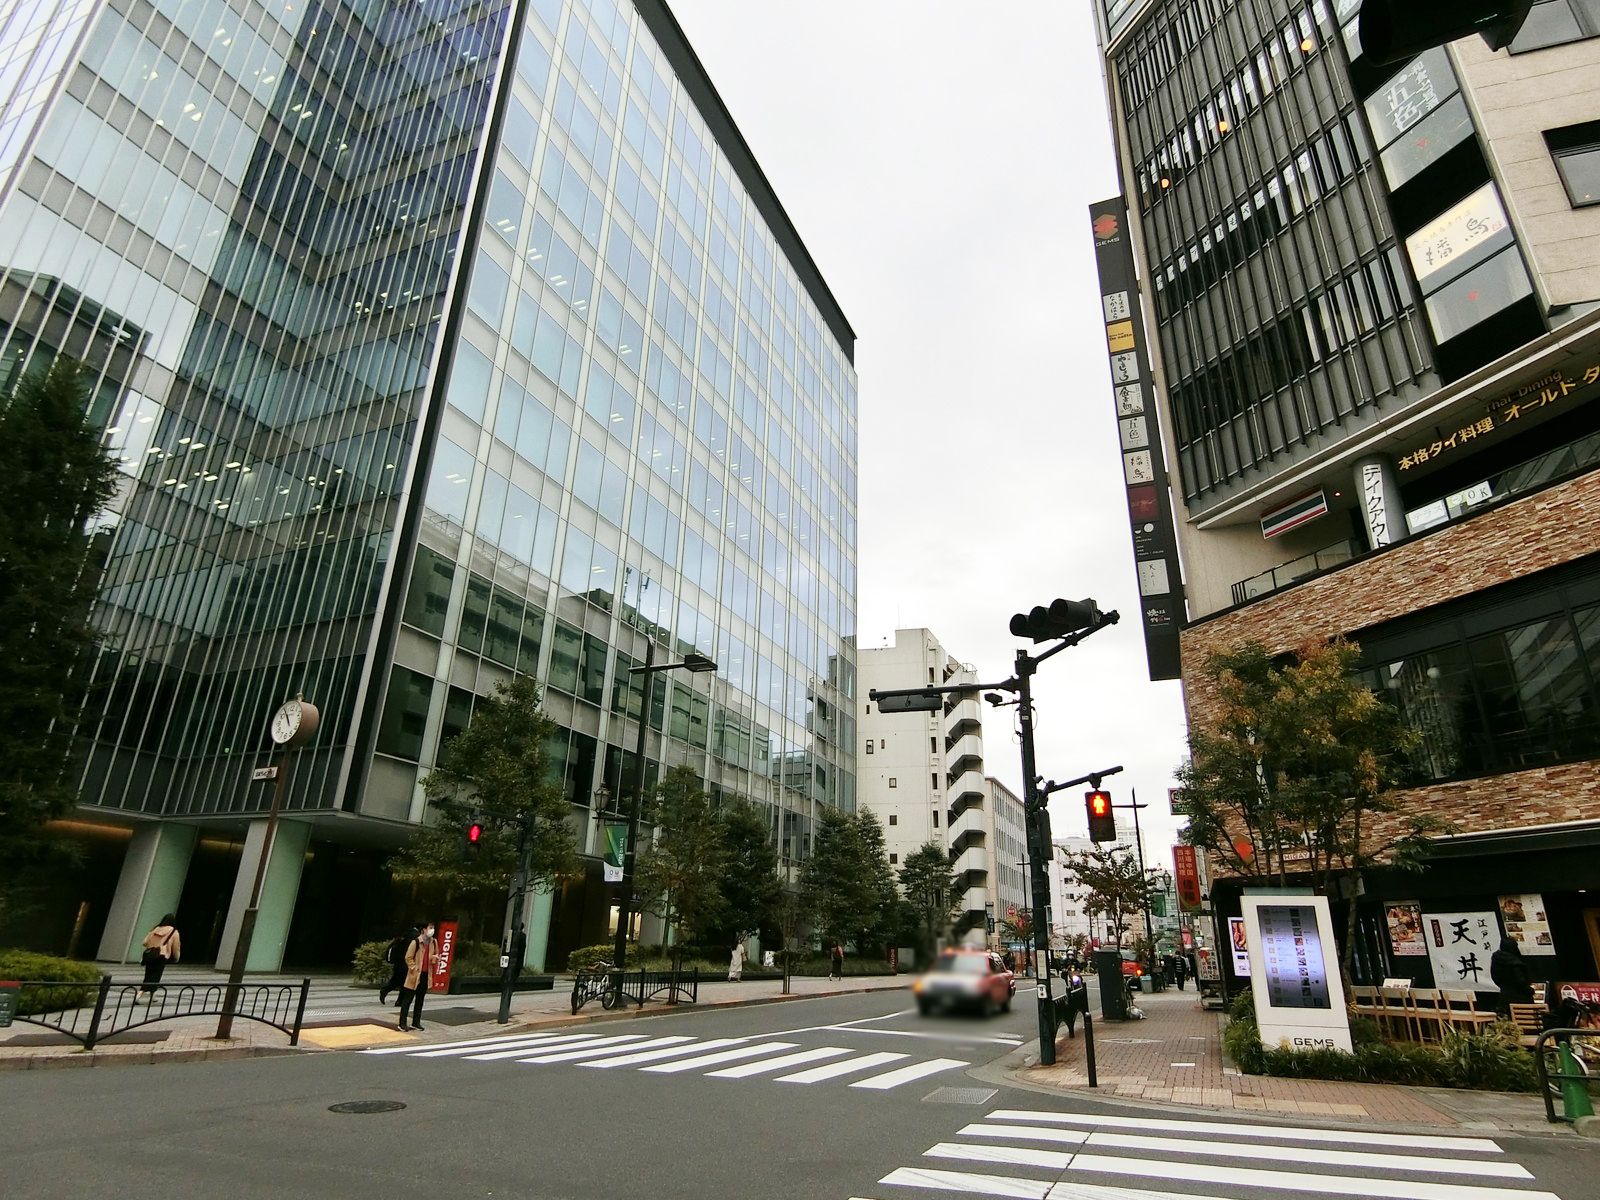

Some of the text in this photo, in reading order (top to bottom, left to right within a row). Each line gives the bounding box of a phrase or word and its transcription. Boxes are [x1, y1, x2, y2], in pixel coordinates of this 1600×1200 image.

[1096, 237, 1120, 247] GEMS
[1519, 371, 1562, 397] Dining
[1398, 416, 1495, 470] 本格タイ料理
[1364, 467, 1388, 547] テイクアウト
[439, 931, 453, 975] DIGITAL
[1450, 918, 1484, 983] 天丼
[1293, 1037, 1335, 1047] GEMS
